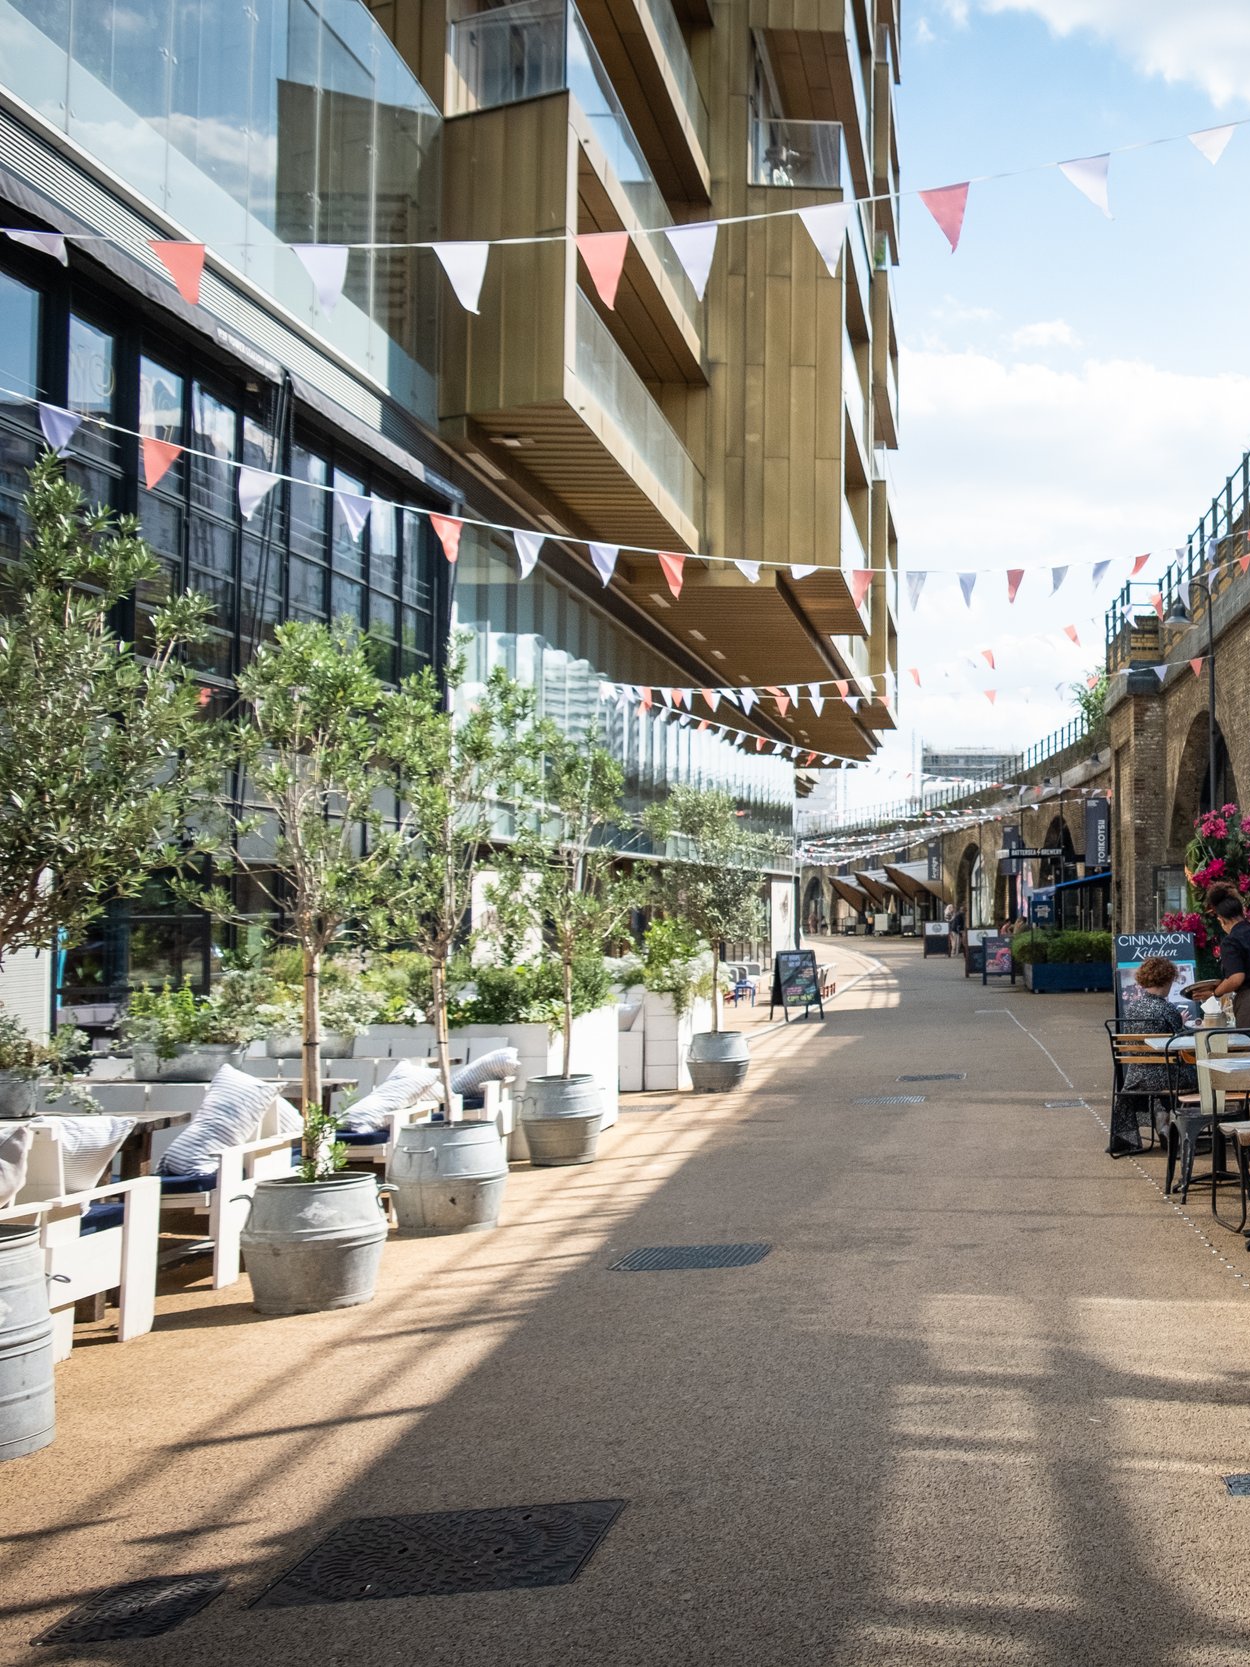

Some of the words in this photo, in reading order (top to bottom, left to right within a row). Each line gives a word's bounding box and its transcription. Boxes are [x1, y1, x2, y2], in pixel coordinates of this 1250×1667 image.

[1098, 819, 1106, 863] TONKOTSU
[1118, 934, 1191, 947] CINNAMON
[1132, 942, 1178, 960] Kitchen
